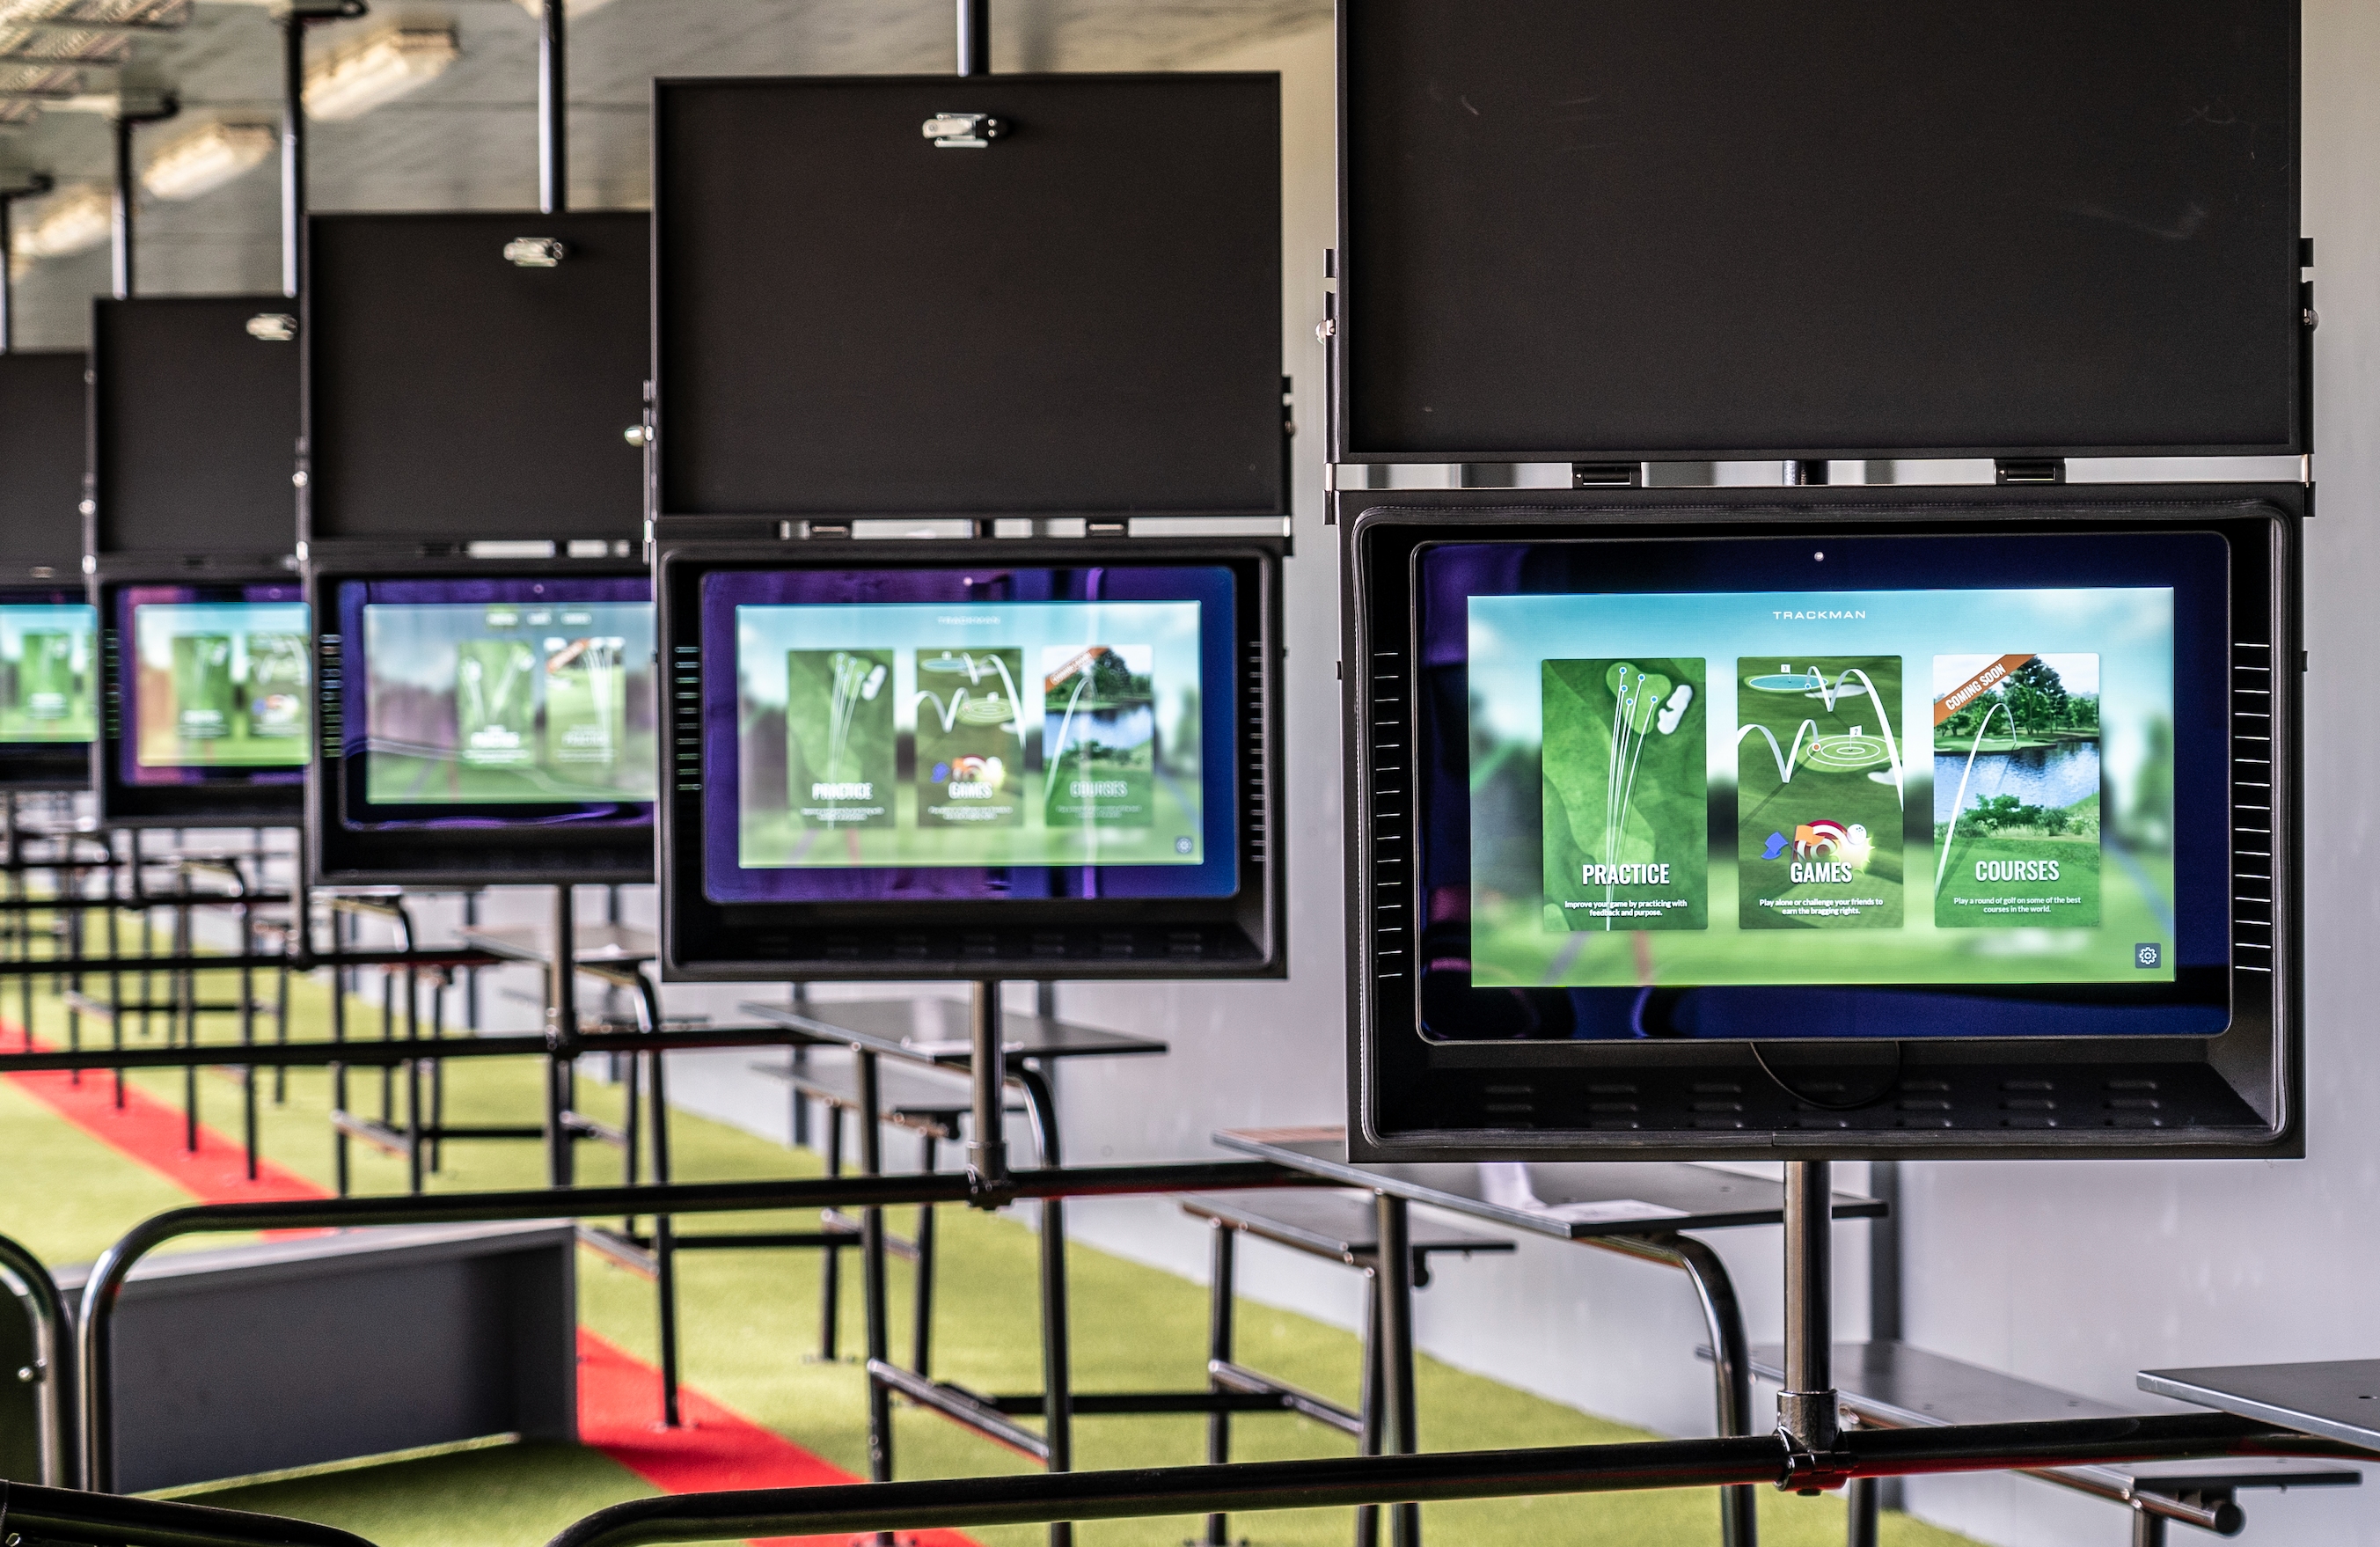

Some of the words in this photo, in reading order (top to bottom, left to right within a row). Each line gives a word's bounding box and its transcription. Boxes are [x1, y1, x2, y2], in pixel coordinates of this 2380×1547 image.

[1772, 610, 1866, 620] TRACKMAN
[1944, 680, 1983, 711] COMING
[1979, 663, 2006, 686] SOON
[1582, 863, 1670, 884] PRACTICE
[1790, 861, 1853, 883] GAMES
[1975, 860, 2060, 882] COURSES
[1564, 900, 1593, 909] Improve
[1629, 899, 1637, 909] by
[1637, 899, 1672, 909] practicing
[1759, 898, 1775, 908] Play
[1802, 898, 1834, 907] challenge
[1850, 898, 1875, 906] friends
[1953, 897, 1969, 905] Play
[2003, 897, 2017, 905] golf
[1589, 908, 1621, 917] feedback
[1634, 909, 1663, 918] purpose.
[1810, 907, 1840, 916] bragging
[1839, 906, 1861, 916] rights.
